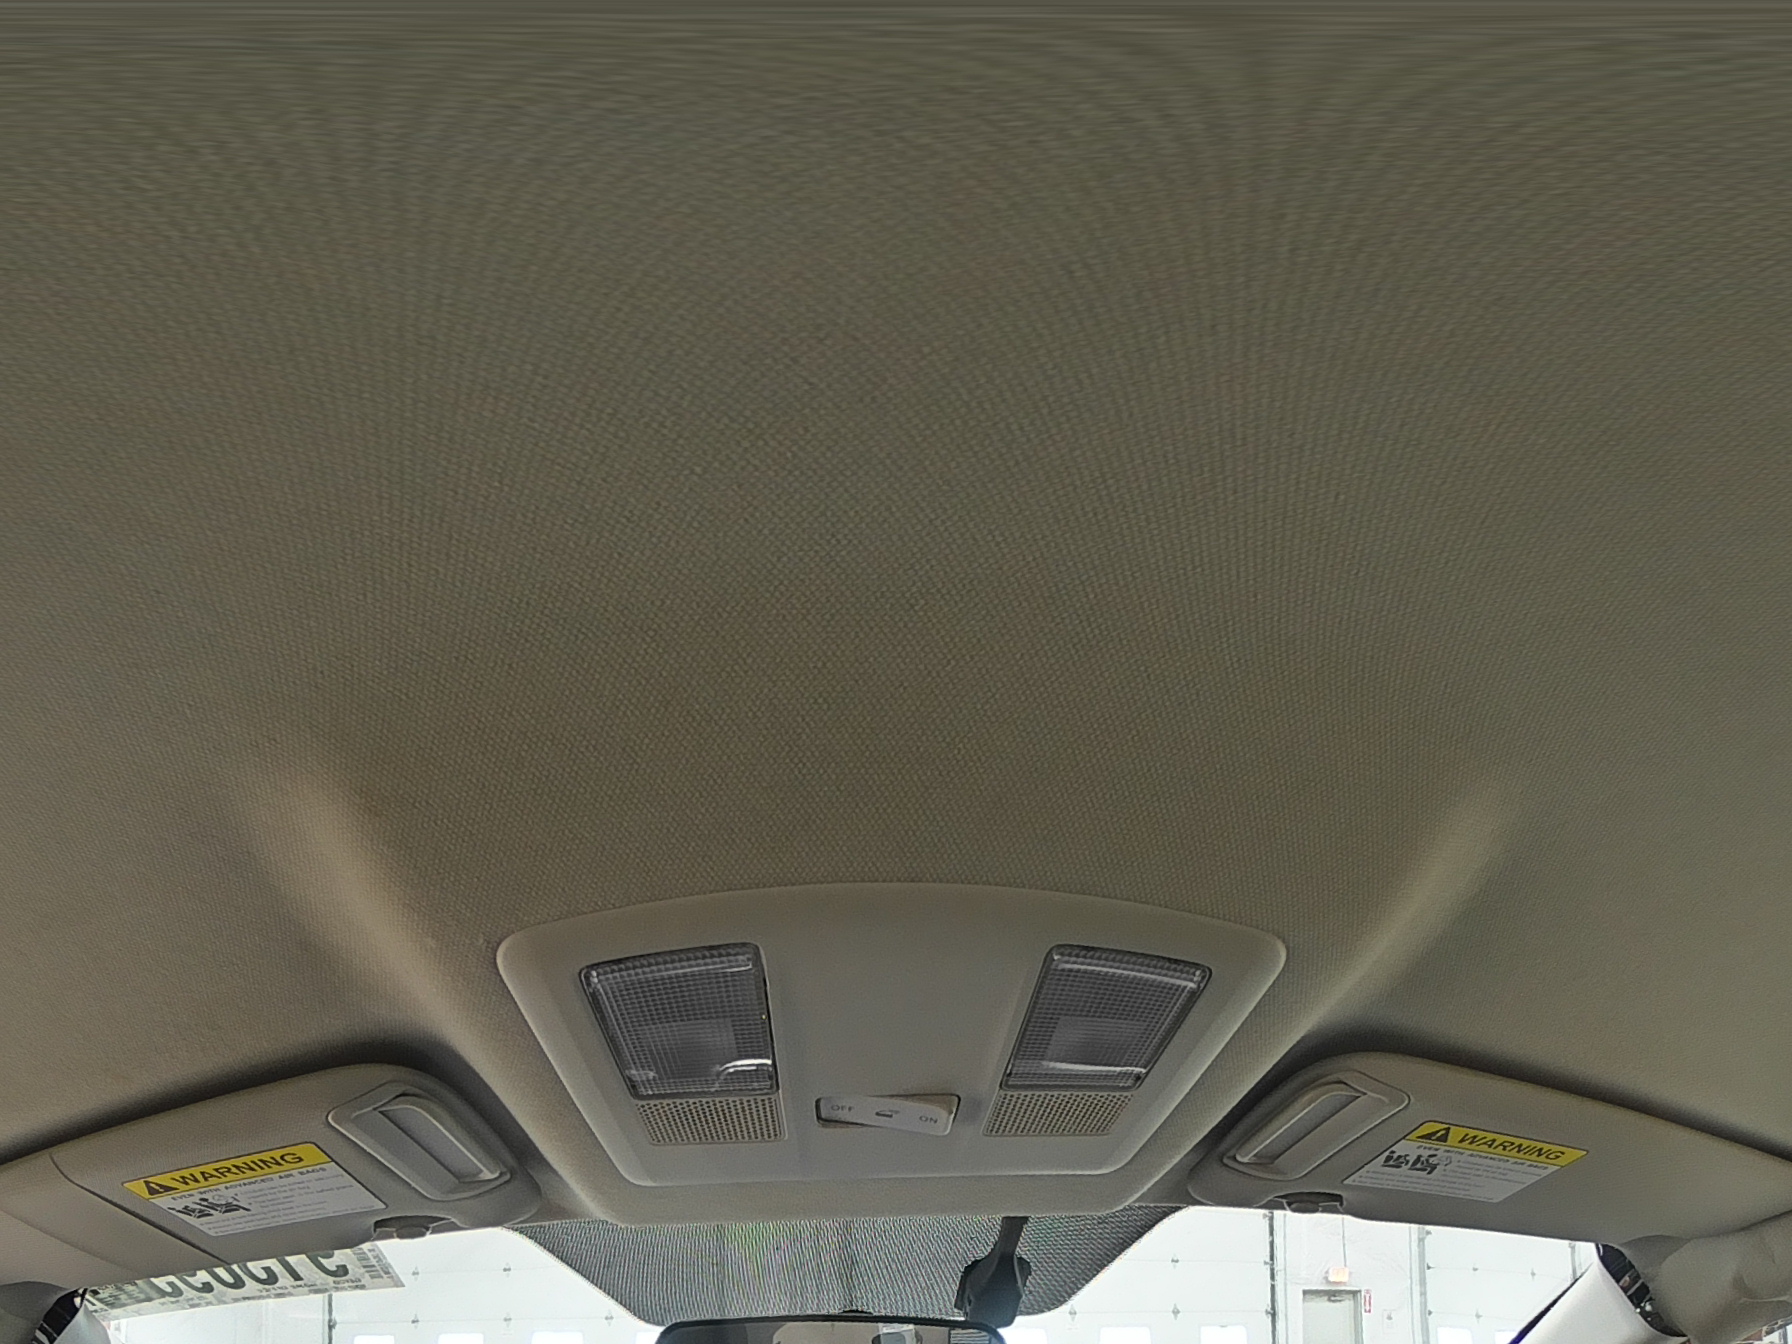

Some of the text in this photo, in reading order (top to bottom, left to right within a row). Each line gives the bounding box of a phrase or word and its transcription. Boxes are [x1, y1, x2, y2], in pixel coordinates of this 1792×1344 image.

[830, 1104, 855, 1112] OFF
[919, 1115, 938, 1124] ON
[1457, 1132, 1566, 1161] WARNING
[171, 1152, 304, 1187] WARNING
[224, 1177, 275, 1191] ADVANCED
[278, 1173, 297, 1182] AIR
[300, 1167, 327, 1177] BAGS
